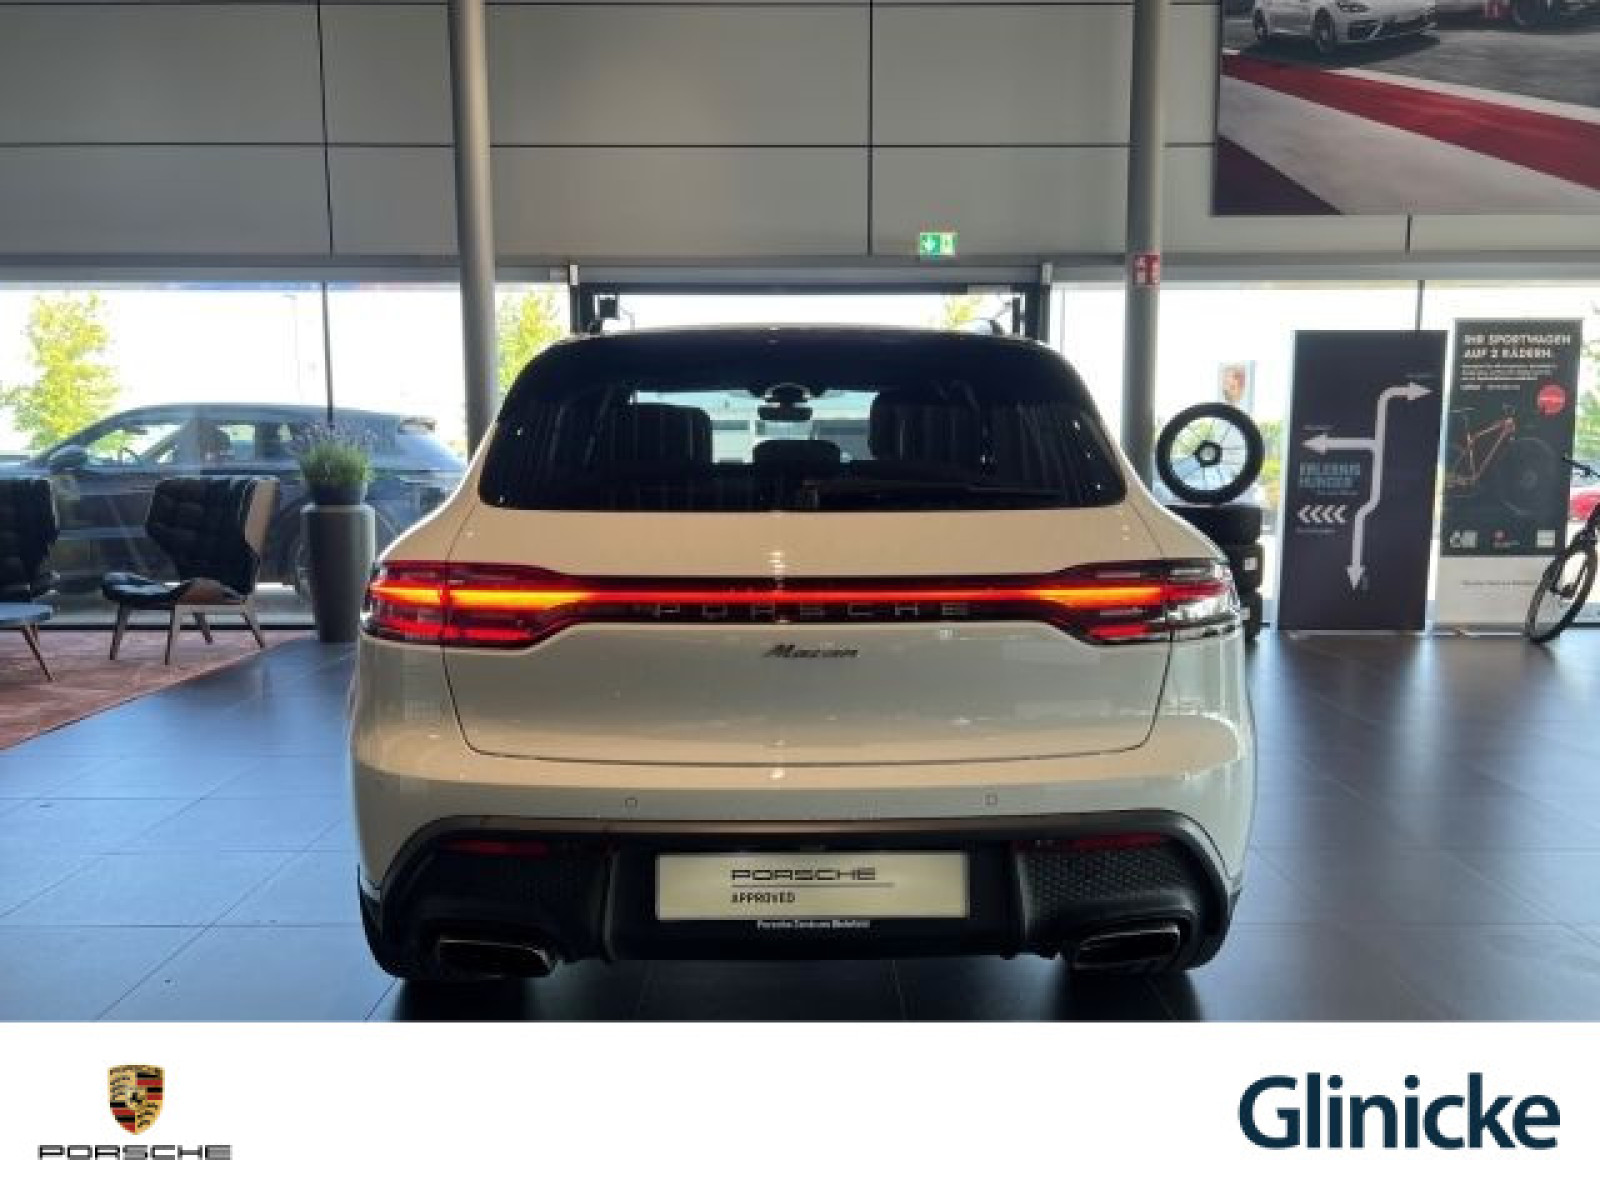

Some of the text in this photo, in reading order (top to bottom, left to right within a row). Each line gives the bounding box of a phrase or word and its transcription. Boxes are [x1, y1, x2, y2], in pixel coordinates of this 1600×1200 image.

[1464, 334, 1571, 345] IHR SPORTWAGEN
[1463, 348, 1487, 358] AUF
[653, 602, 969, 616] PORSCHE
[763, 643, 860, 659] Macan
[730, 867, 876, 881] PORSCHE
[731, 891, 796, 904] APPROVED
